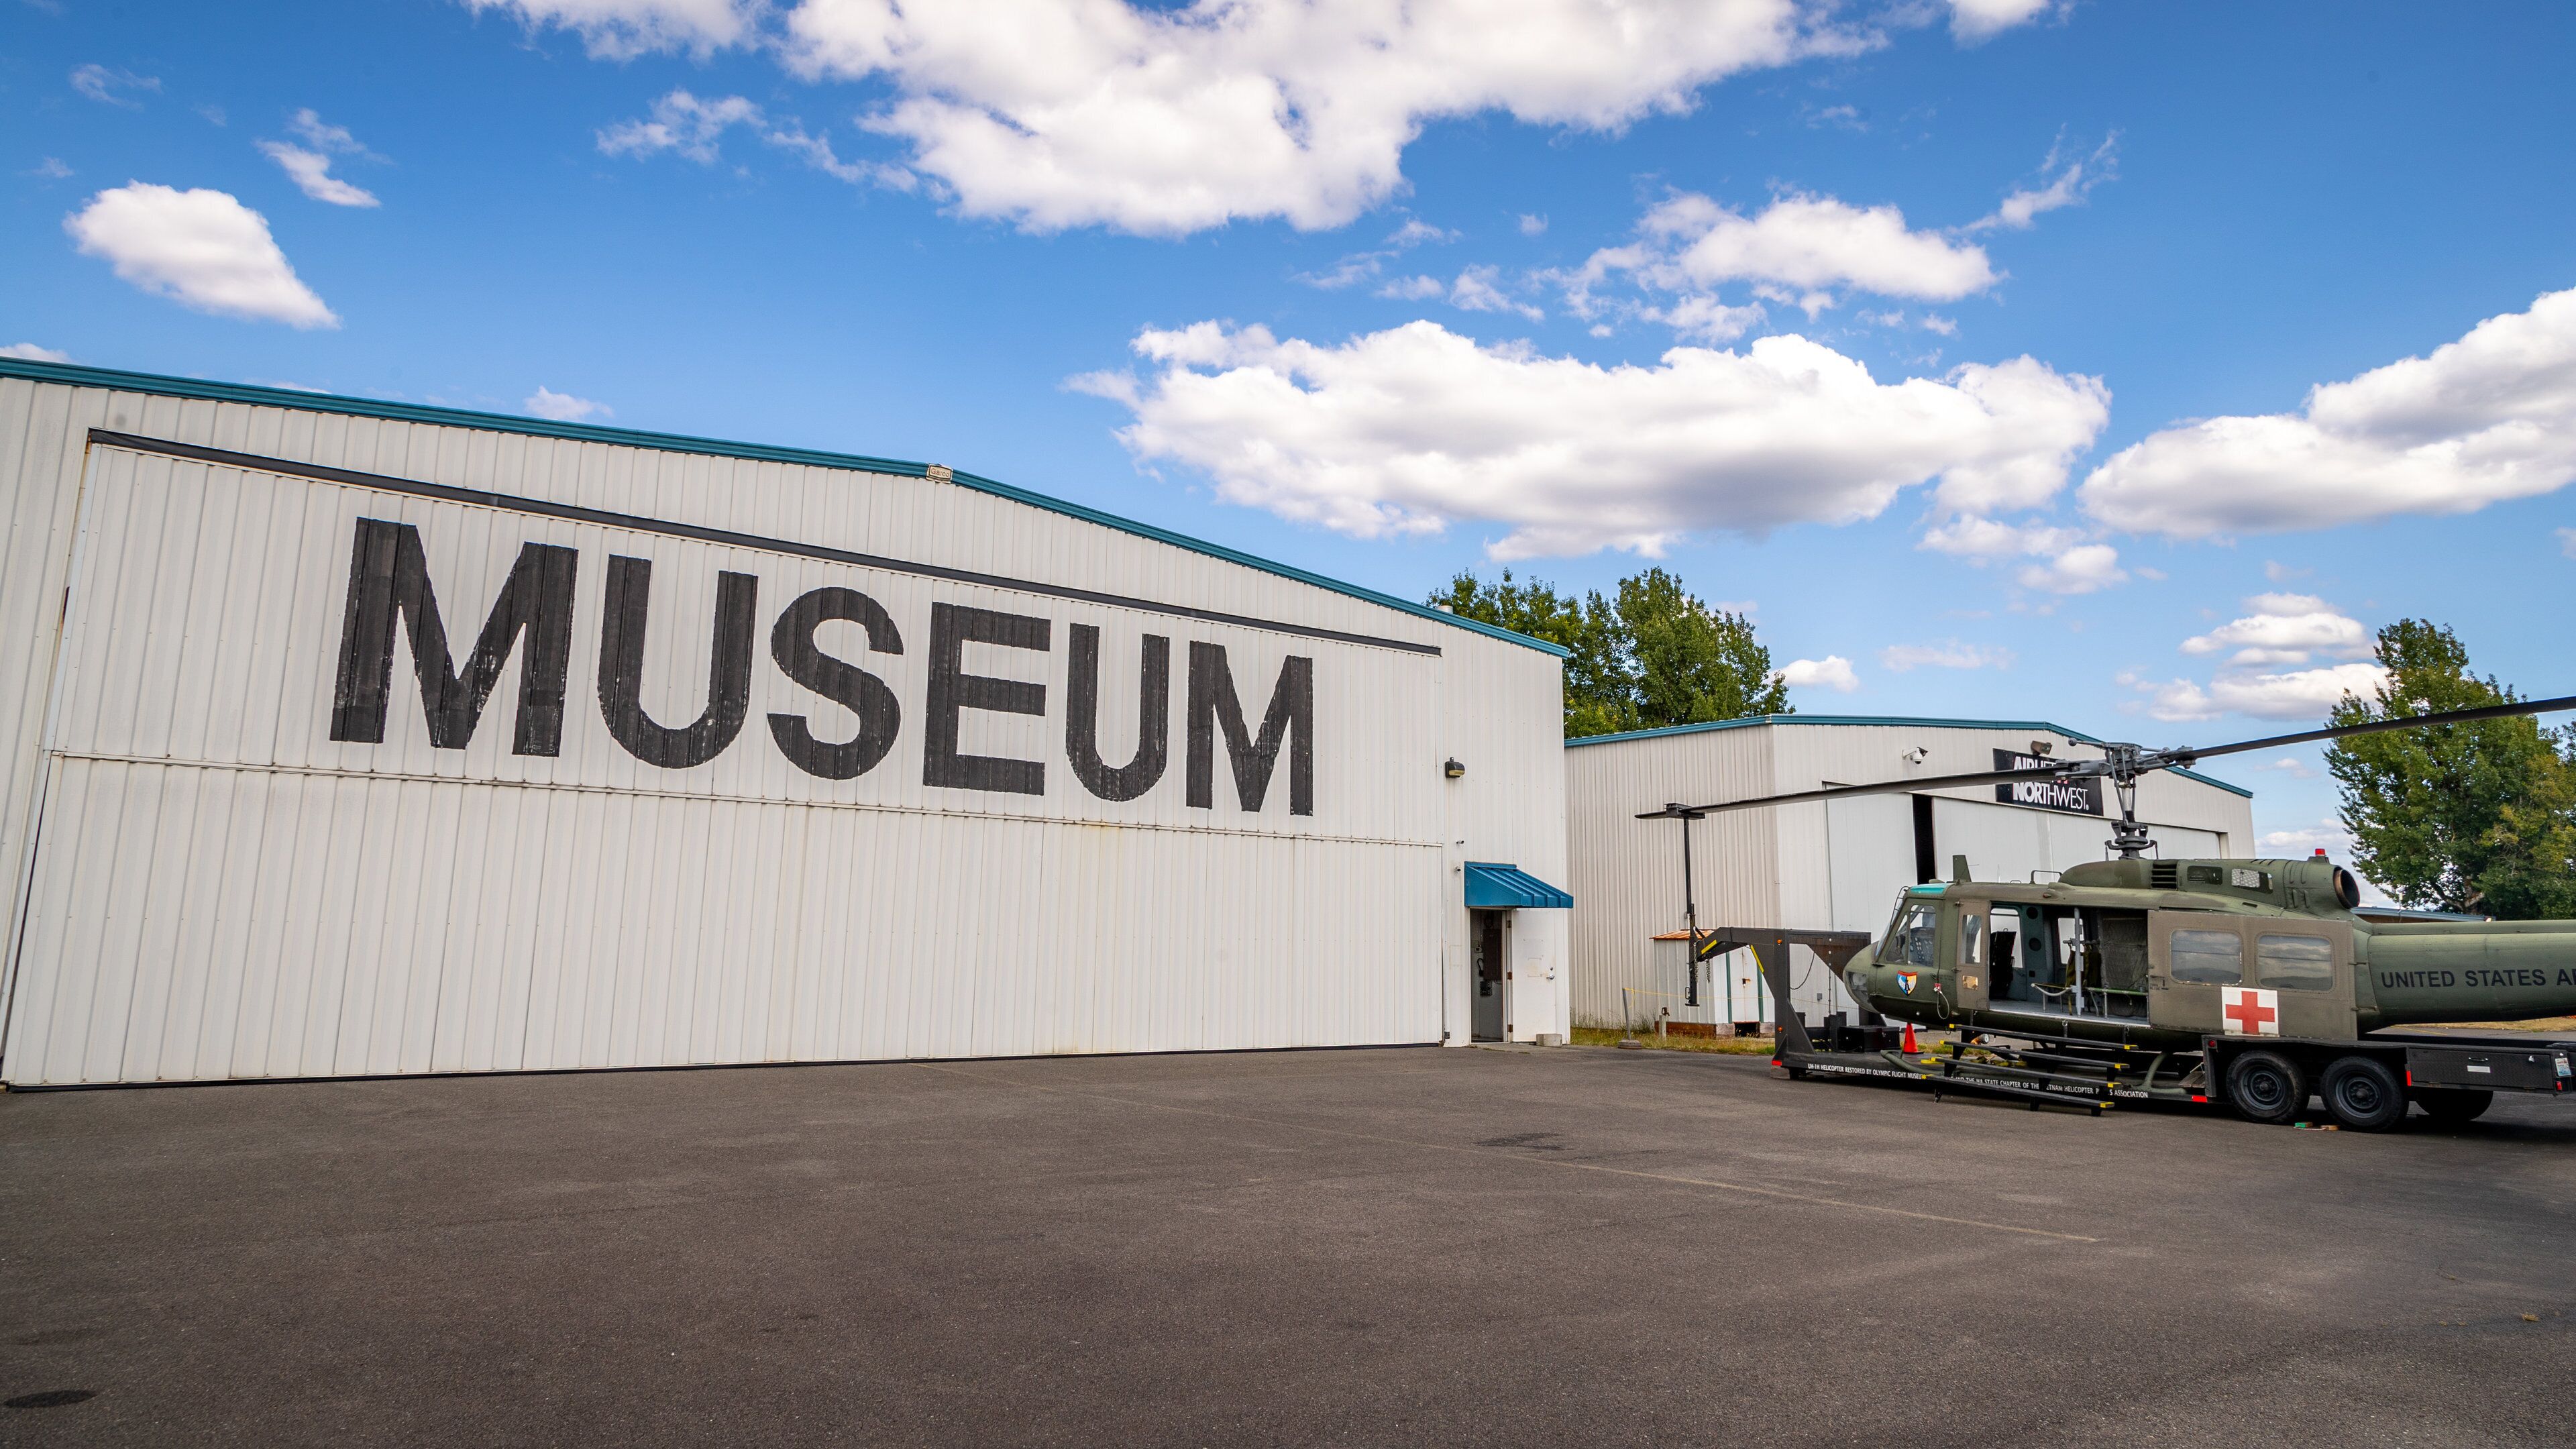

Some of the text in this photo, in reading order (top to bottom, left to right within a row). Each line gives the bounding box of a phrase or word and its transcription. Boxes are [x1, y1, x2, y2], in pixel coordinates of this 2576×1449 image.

[330, 517, 1313, 816] MUSEUM
[2381, 971, 2455, 988] UNITED
[2465, 969, 2546, 987] STATES
[2065, 1086, 2094, 1094] HELICOPTER
[2114, 1090, 2149, 1098] ASSOCIATION
